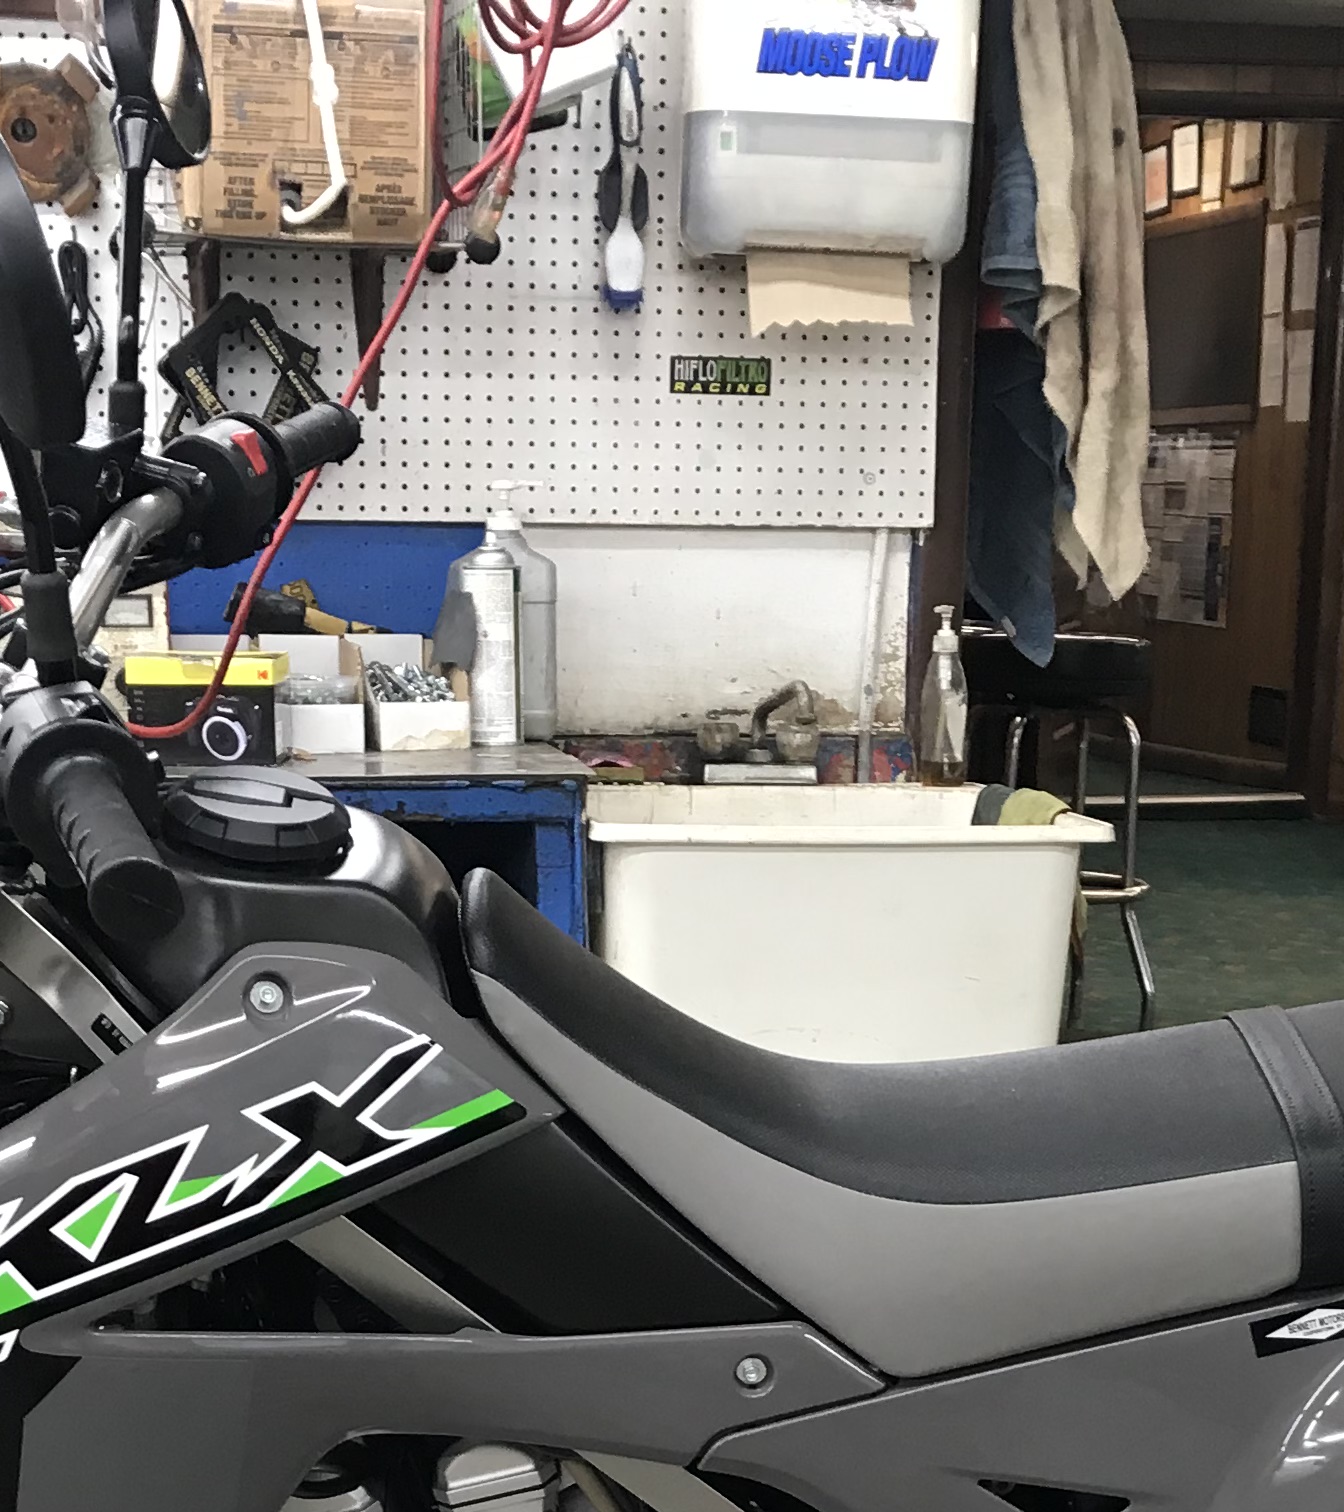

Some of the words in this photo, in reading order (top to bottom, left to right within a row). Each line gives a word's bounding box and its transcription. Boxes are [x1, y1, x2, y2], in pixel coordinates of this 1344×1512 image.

[756, 27, 857, 78] MOOSE
[855, 32, 940, 82] PLOW
[248, 316, 286, 366] HONDA
[673, 381, 767, 394] RACING
